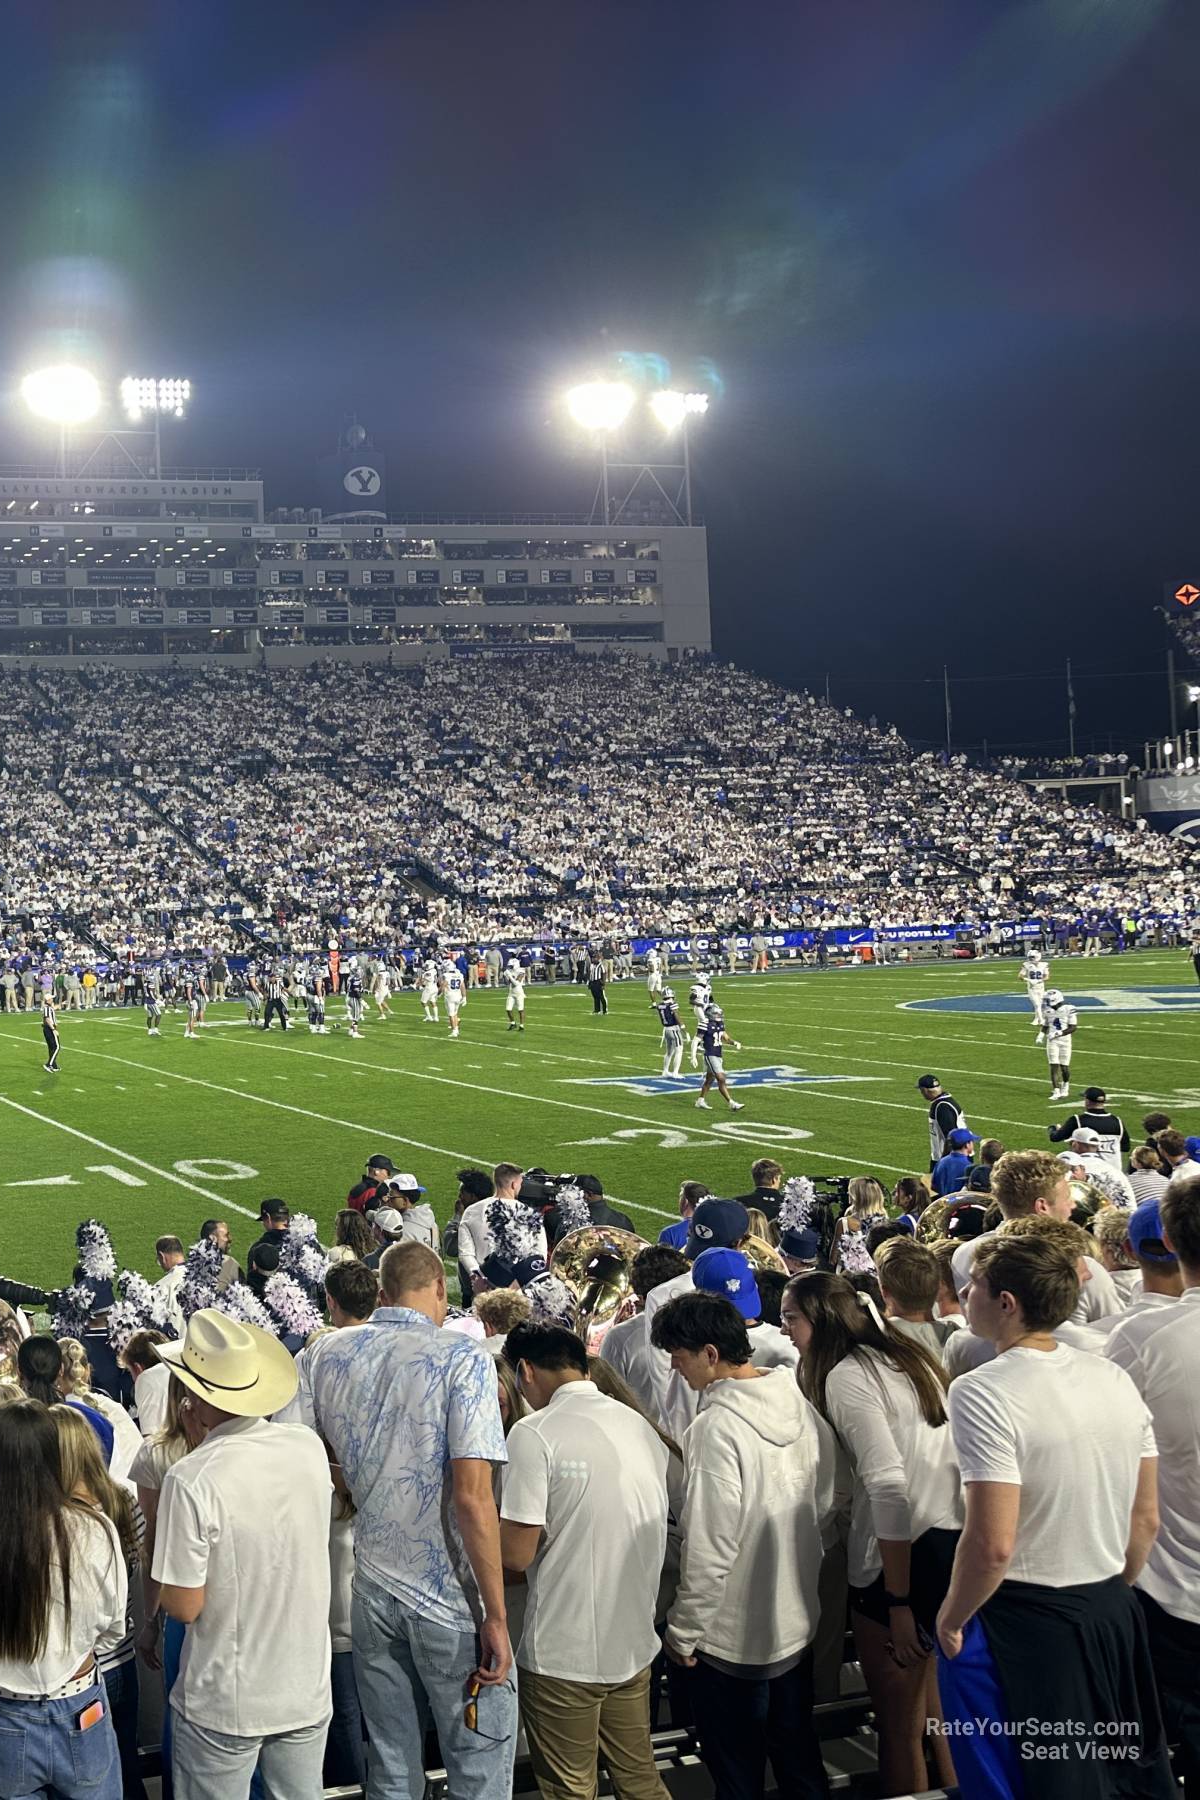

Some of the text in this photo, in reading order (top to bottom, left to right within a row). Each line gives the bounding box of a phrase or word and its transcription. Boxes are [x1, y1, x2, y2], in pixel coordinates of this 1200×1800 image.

[74, 486, 149, 496] EDWARDS
[161, 486, 233, 496] STADIUM
[1030, 970, 1042, 980] 22
[450, 980, 462, 990] 93
[1053, 1018, 1062, 1030] 4
[611, 1121, 815, 1149] 20
[83, 1158, 260, 1187] 10
